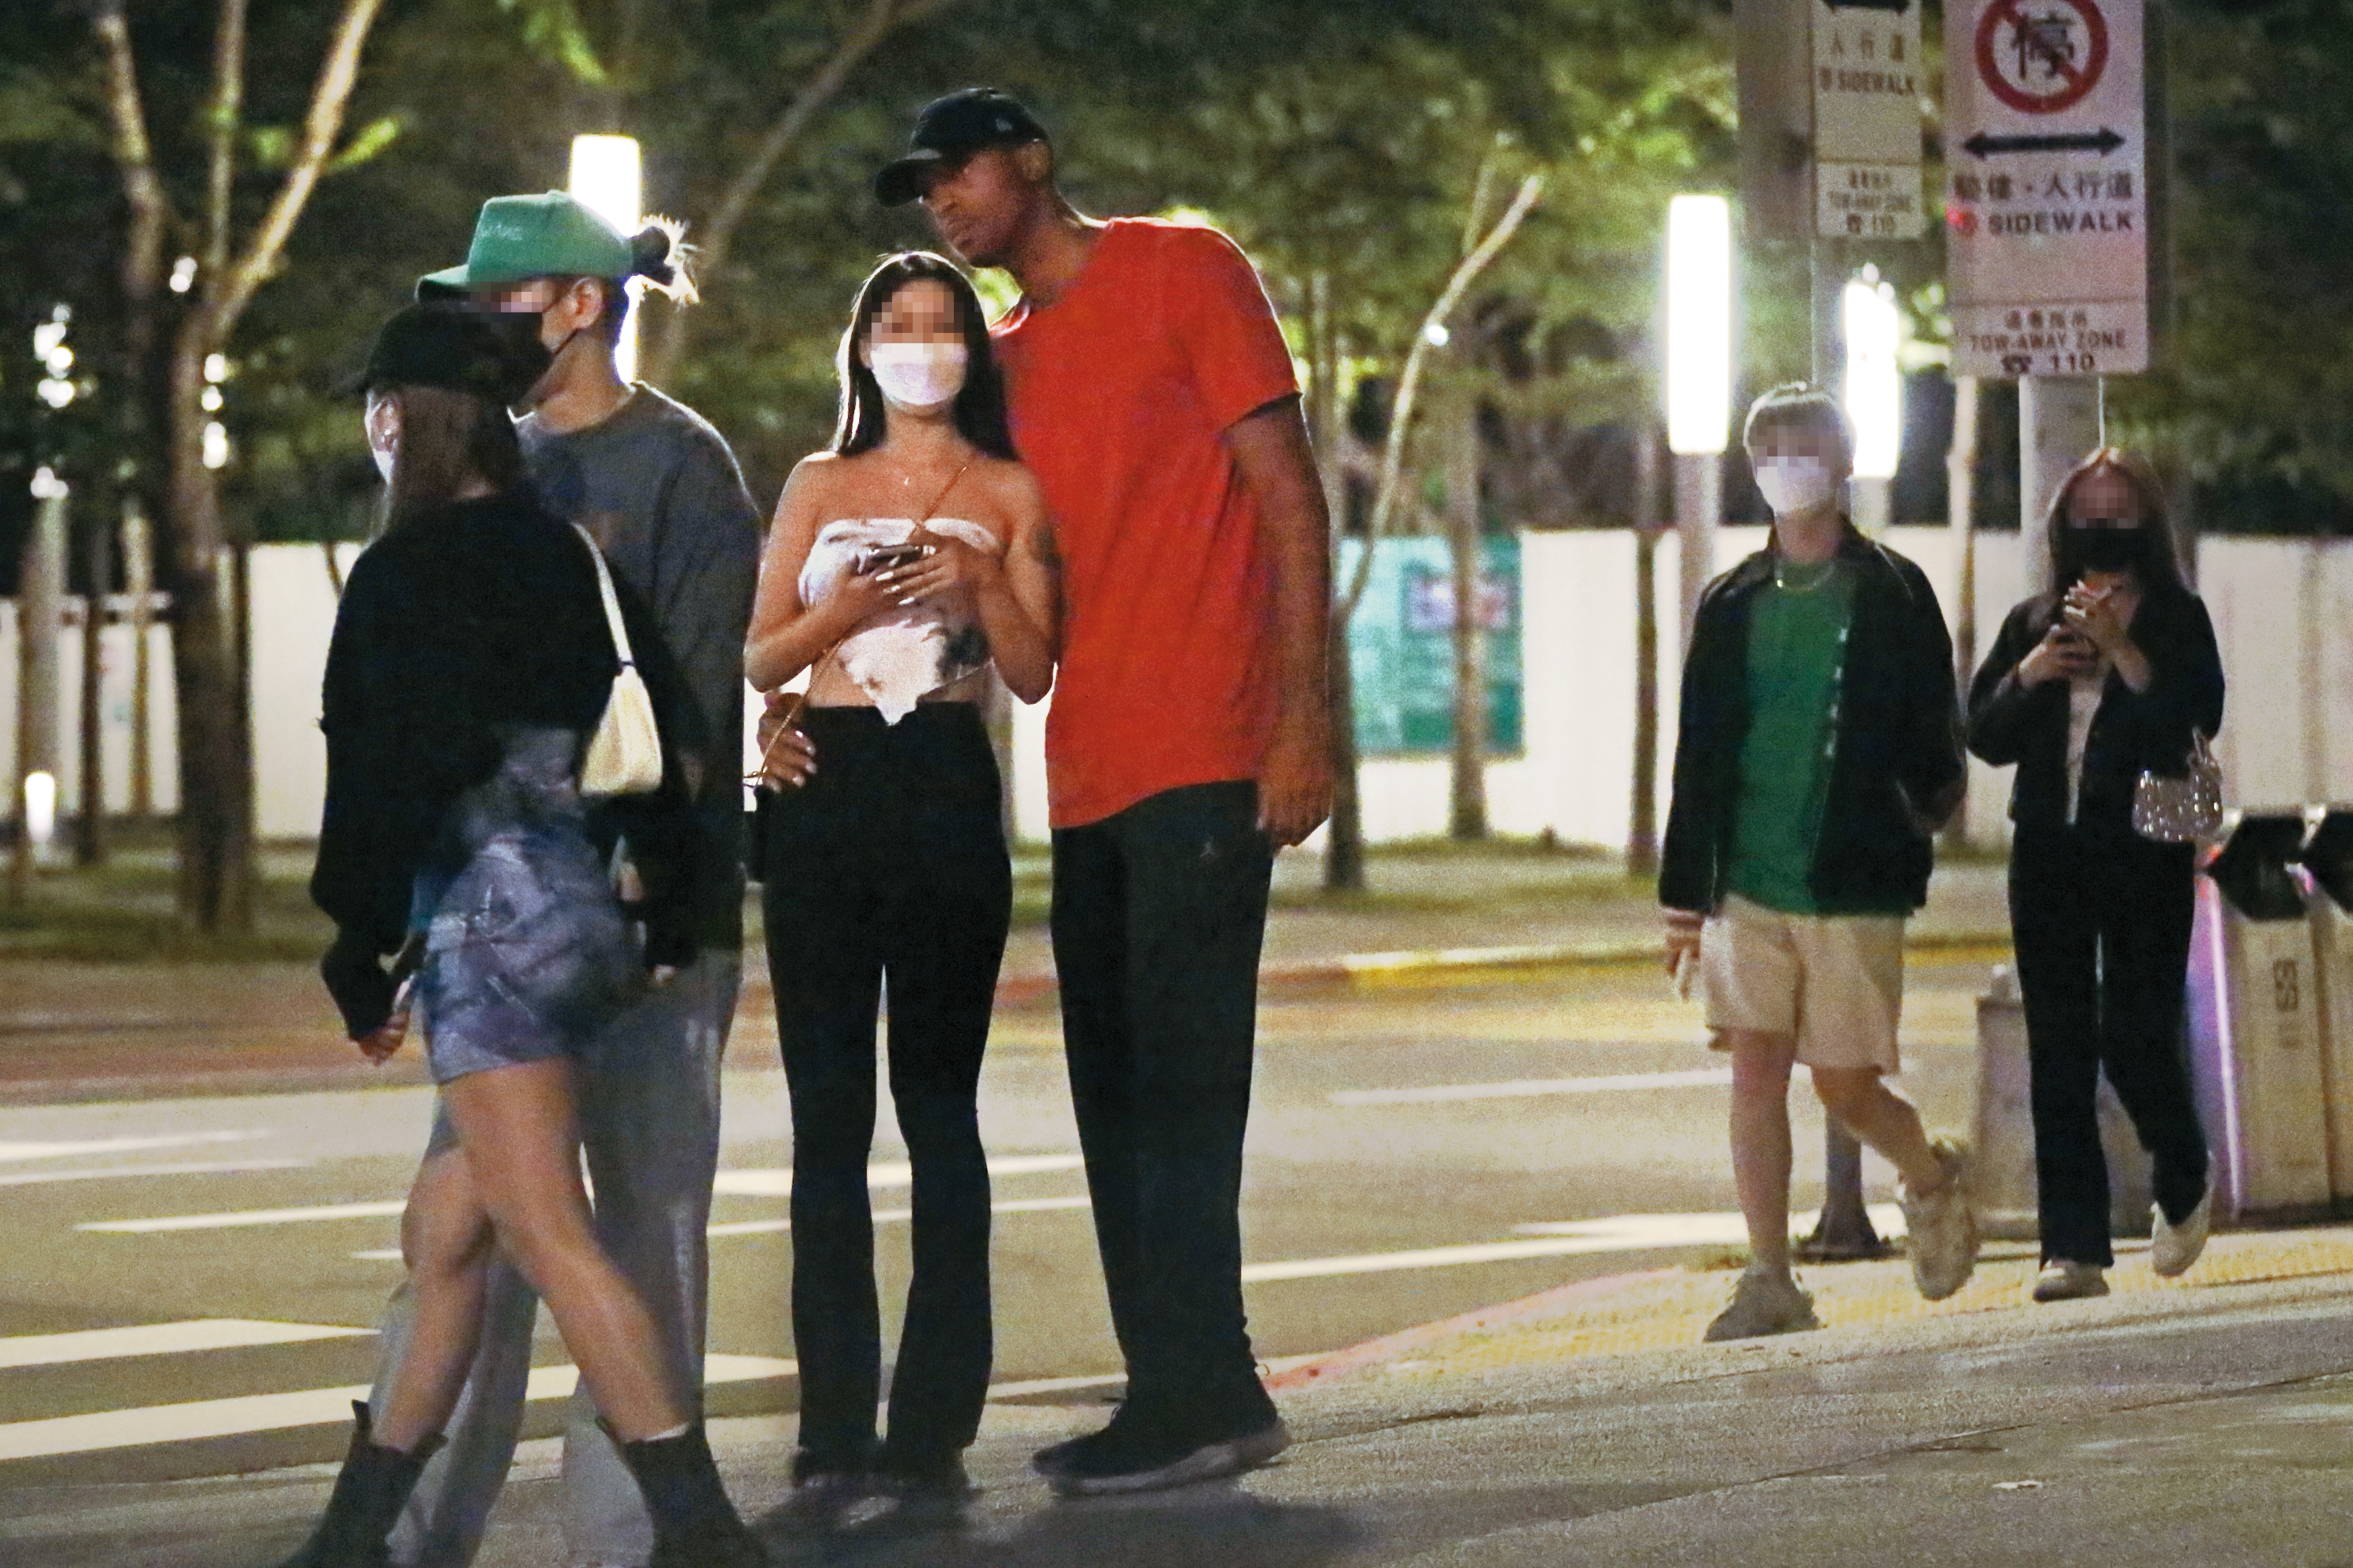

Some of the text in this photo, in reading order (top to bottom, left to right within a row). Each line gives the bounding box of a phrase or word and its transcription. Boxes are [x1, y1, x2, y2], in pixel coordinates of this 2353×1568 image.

[1837, 68, 1915, 96] SIDEWALK
[1988, 210, 2132, 236] SIDEWALK
[2076, 328, 2125, 350] ZONE
[2051, 352, 2096, 372] 110
